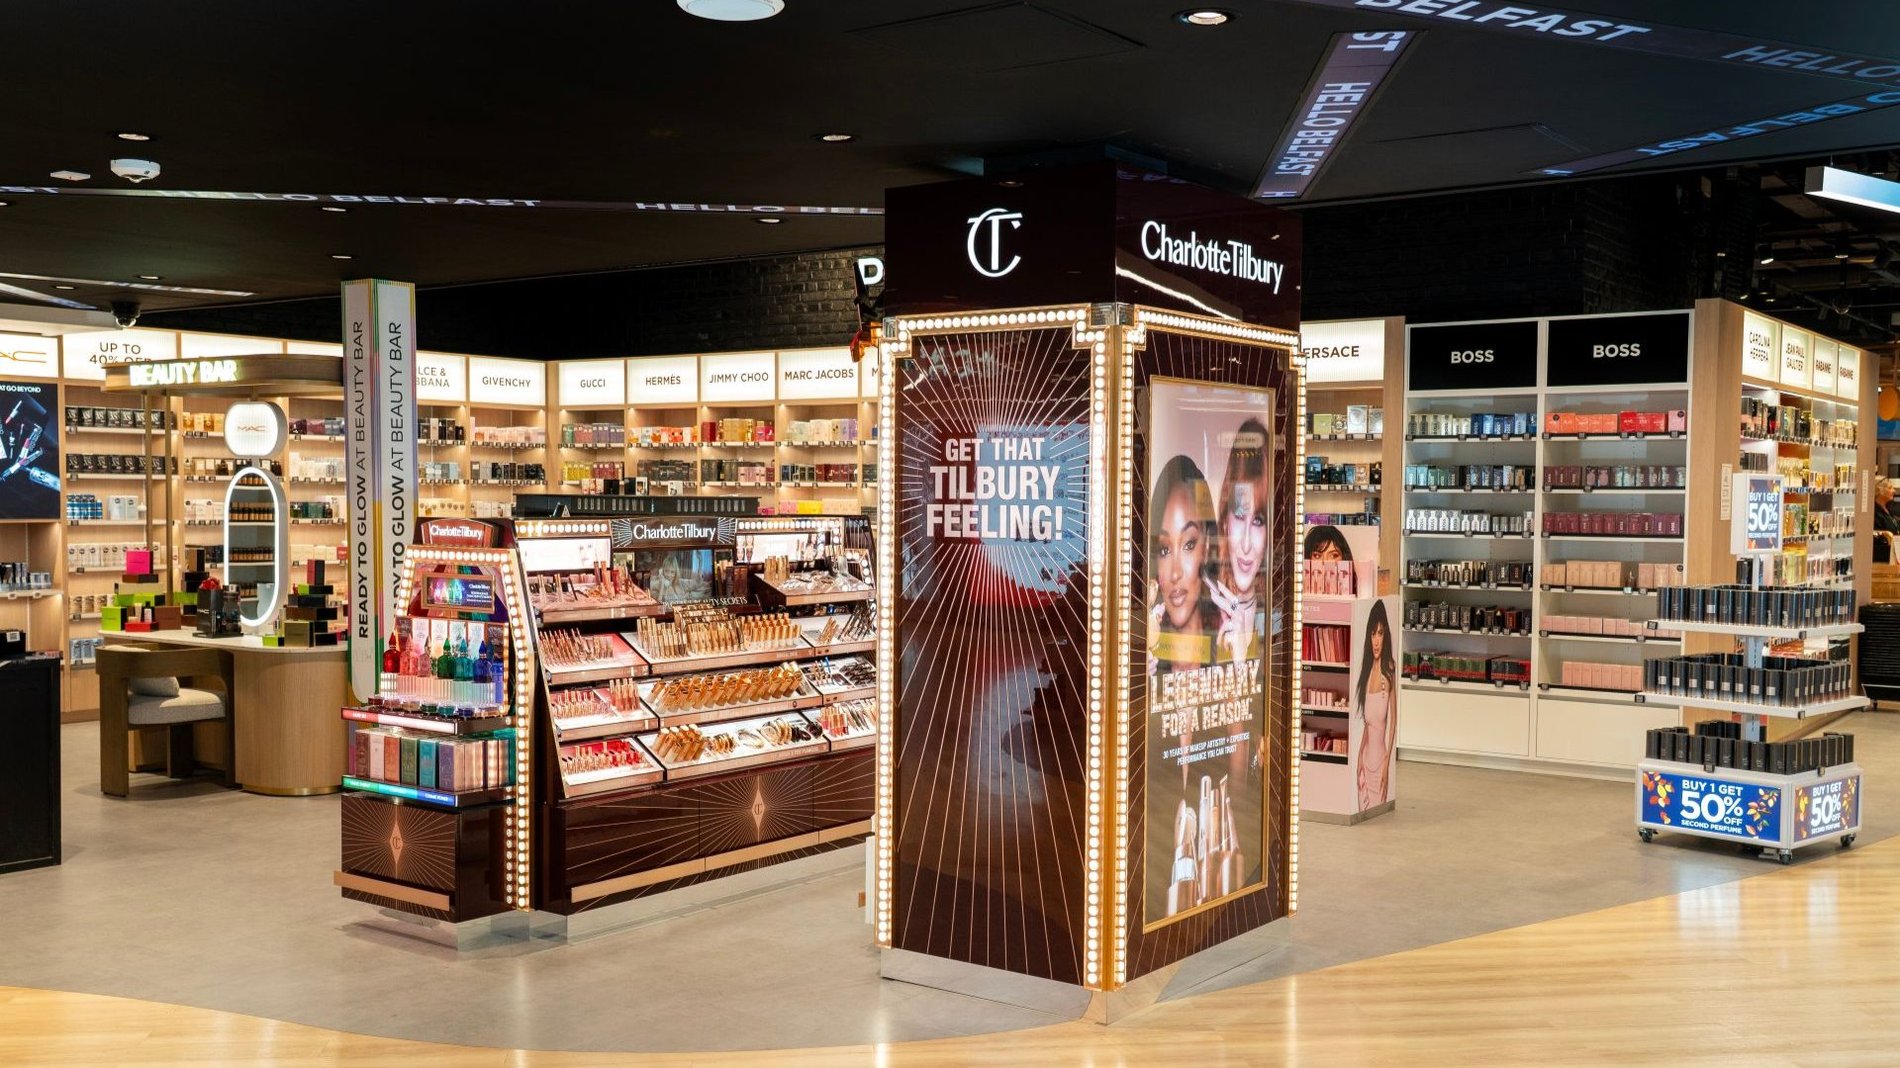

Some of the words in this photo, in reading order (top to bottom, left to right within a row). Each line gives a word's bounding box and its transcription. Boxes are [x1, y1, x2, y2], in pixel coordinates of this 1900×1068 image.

[1302, 82, 1372, 128] HELLO
[1275, 129, 1340, 176] BELFAST
[330, 195, 541, 207] BELFAST
[636, 202, 786, 213] HELLO
[99, 342, 118, 353] UP
[122, 343, 142, 355] TO
[353, 321, 363, 360] BAR
[389, 321, 402, 361] BAR
[1592, 344, 1641, 358] BOSS
[1450, 350, 1495, 364] BOSS
[129, 361, 198, 387] BEAUTY
[200, 359, 238, 384] BAR
[482, 376, 532, 388] GIVENCHY
[580, 379, 606, 389] GUCCI
[709, 373, 738, 384] JIMMY
[740, 372, 769, 383] CHOO
[785, 370, 812, 381] MARC
[815, 368, 854, 380] JACOBS
[353, 365, 365, 442] BEAUTY
[389, 365, 404, 442] BEAUTY
[355, 447, 366, 471] AT
[391, 447, 404, 471] AT
[945, 438, 984, 462] GET
[991, 436, 1045, 461] THAT
[929, 465, 1061, 501] TILBURY
[356, 475, 367, 537] GLOW
[391, 475, 405, 537] GLOW
[1749, 492, 1763, 502] BUY
[1766, 492, 1779, 502] GET
[926, 503, 1063, 541] FEELING!
[1748, 502, 1778, 531] 50%
[357, 541, 367, 571] TO
[392, 542, 405, 571] TO
[358, 572, 368, 639] READY
[1161, 709, 1188, 739] FOR
[1190, 706, 1200, 732] A
[1207, 750, 1216, 758] YOU
[1216, 748, 1225, 756] CAN
[1225, 744, 1238, 755] TRUST
[1682, 779, 1708, 791] BUY
[1710, 782, 1715, 793] 1
[1718, 783, 1744, 796] GET
[1812, 785, 1826, 797] BUY
[1830, 782, 1842, 793] GET
[1680, 790, 1744, 823] 50%
[1810, 793, 1841, 827] 50%
[1681, 819, 1709, 830] SECOND
[1710, 824, 1743, 835] PERFUME
[1723, 816, 1743, 827] OFF
